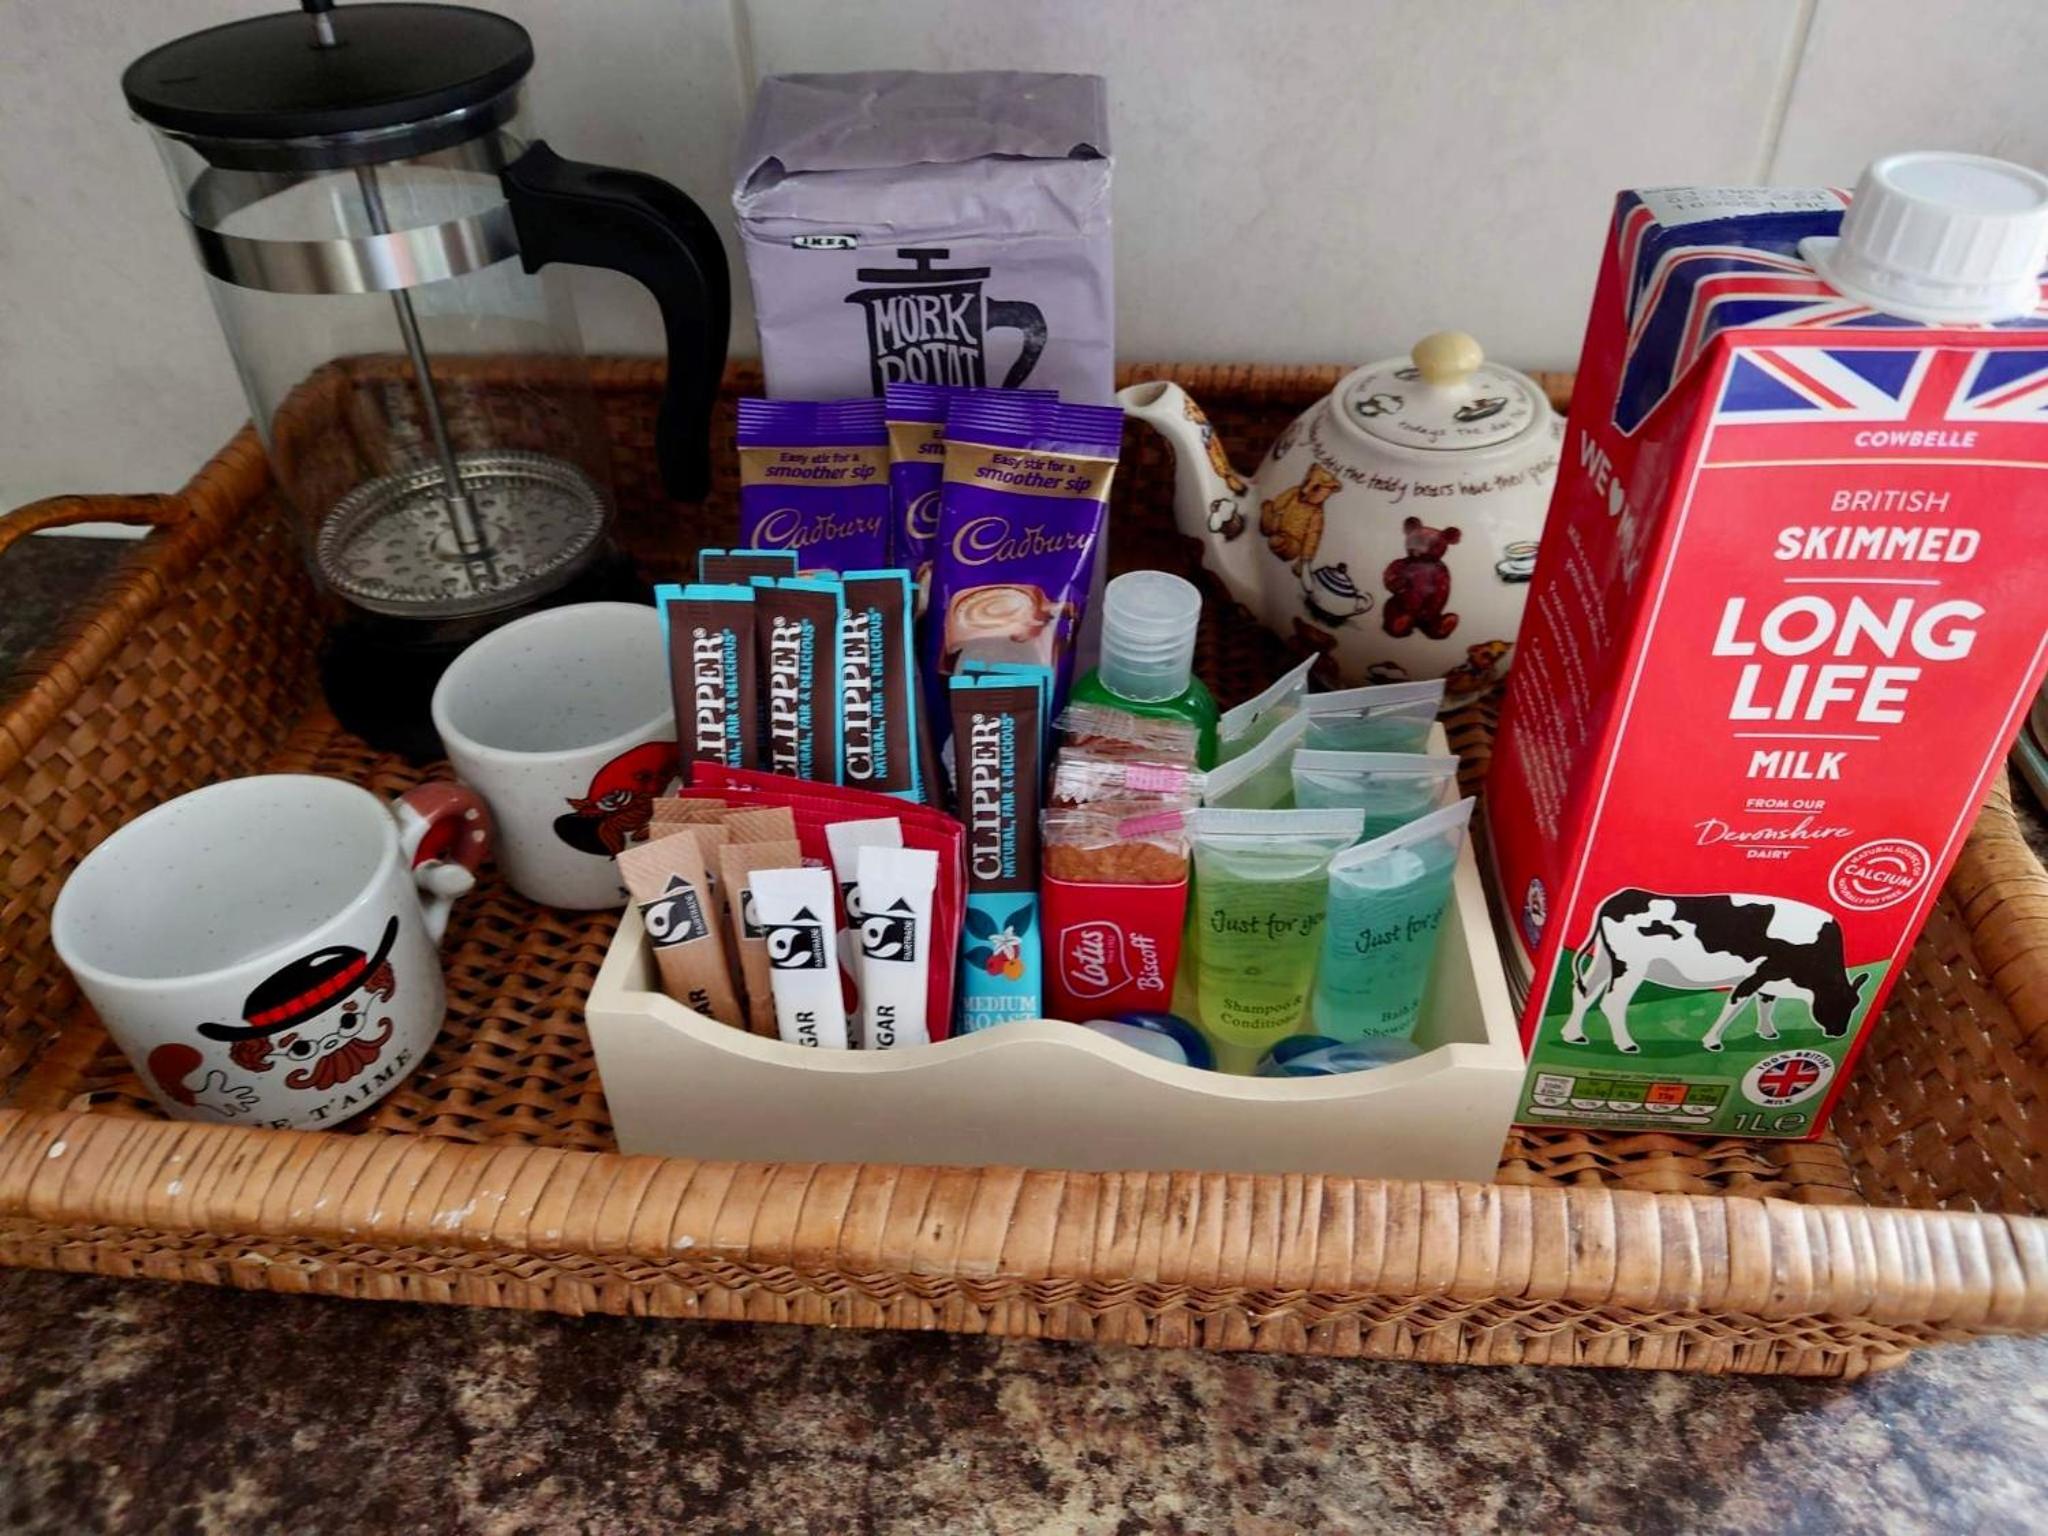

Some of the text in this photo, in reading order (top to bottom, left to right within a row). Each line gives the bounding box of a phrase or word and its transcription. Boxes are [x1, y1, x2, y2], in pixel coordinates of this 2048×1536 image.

[801, 236, 850, 248] IKEA
[1853, 430, 1979, 448] COWBELLE
[764, 464, 877, 481] smoother sip
[992, 453, 1076, 473] Easy stir for a
[975, 466, 1092, 494] smoother sip
[1830, 489, 1951, 513] BRITISH
[750, 508, 883, 550] Cadbury
[951, 516, 1094, 566] Cadbury
[1774, 525, 1981, 564] SKIMMED
[1711, 595, 1987, 661] LONG
[1728, 663, 1923, 724] LIFE
[1746, 750, 1849, 780] MILK
[1000, 790, 1016, 817] FAIR
[1745, 797, 1826, 810] FROM OUR
[1693, 815, 1856, 846] Devonshire
[1745, 849, 1792, 860] DAIRY
[1844, 864, 1915, 888] CALCIUM
[1210, 909, 1258, 934] Just
[1266, 912, 1297, 940] for
[1355, 925, 1401, 954] Just
[1129, 932, 1165, 991] Biscoff
[961, 995, 1037, 1012] MEDIUM
[308, 1047, 413, 1122] T'AIME
